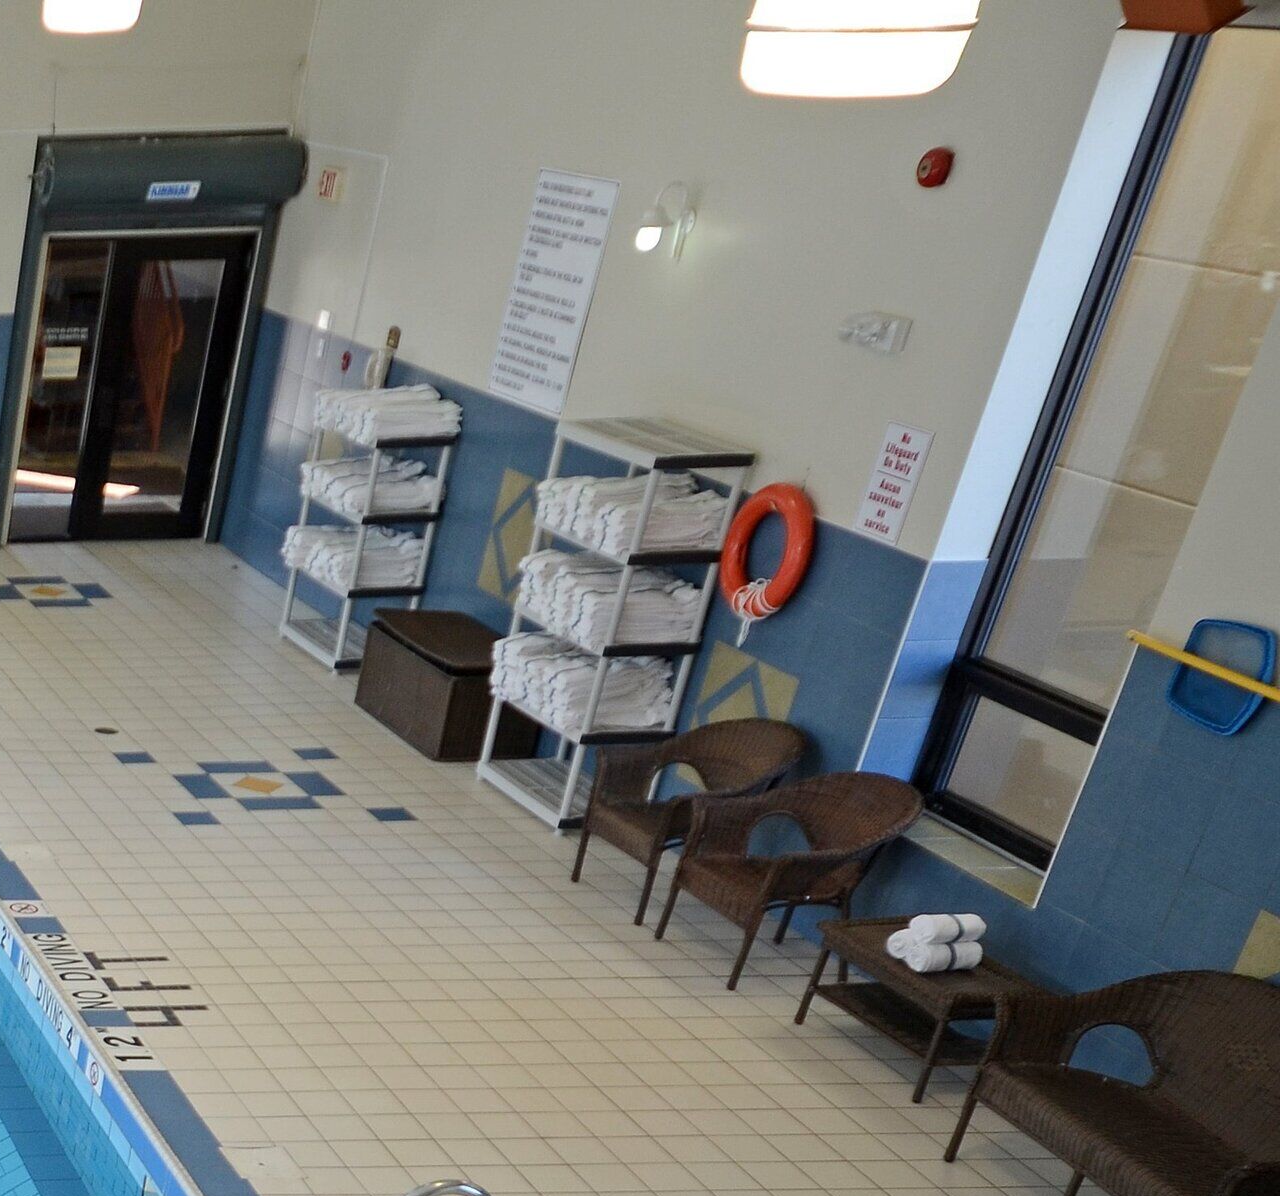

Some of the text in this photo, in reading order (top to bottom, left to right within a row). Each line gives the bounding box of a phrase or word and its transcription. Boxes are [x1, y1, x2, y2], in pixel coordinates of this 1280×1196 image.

[320, 170, 337, 198] EXIT
[901, 432, 912, 444] No
[885, 442, 920, 461] Lifeguard
[33, 933, 118, 1010] NO DIVING
[124, 1005, 209, 1027] 4
